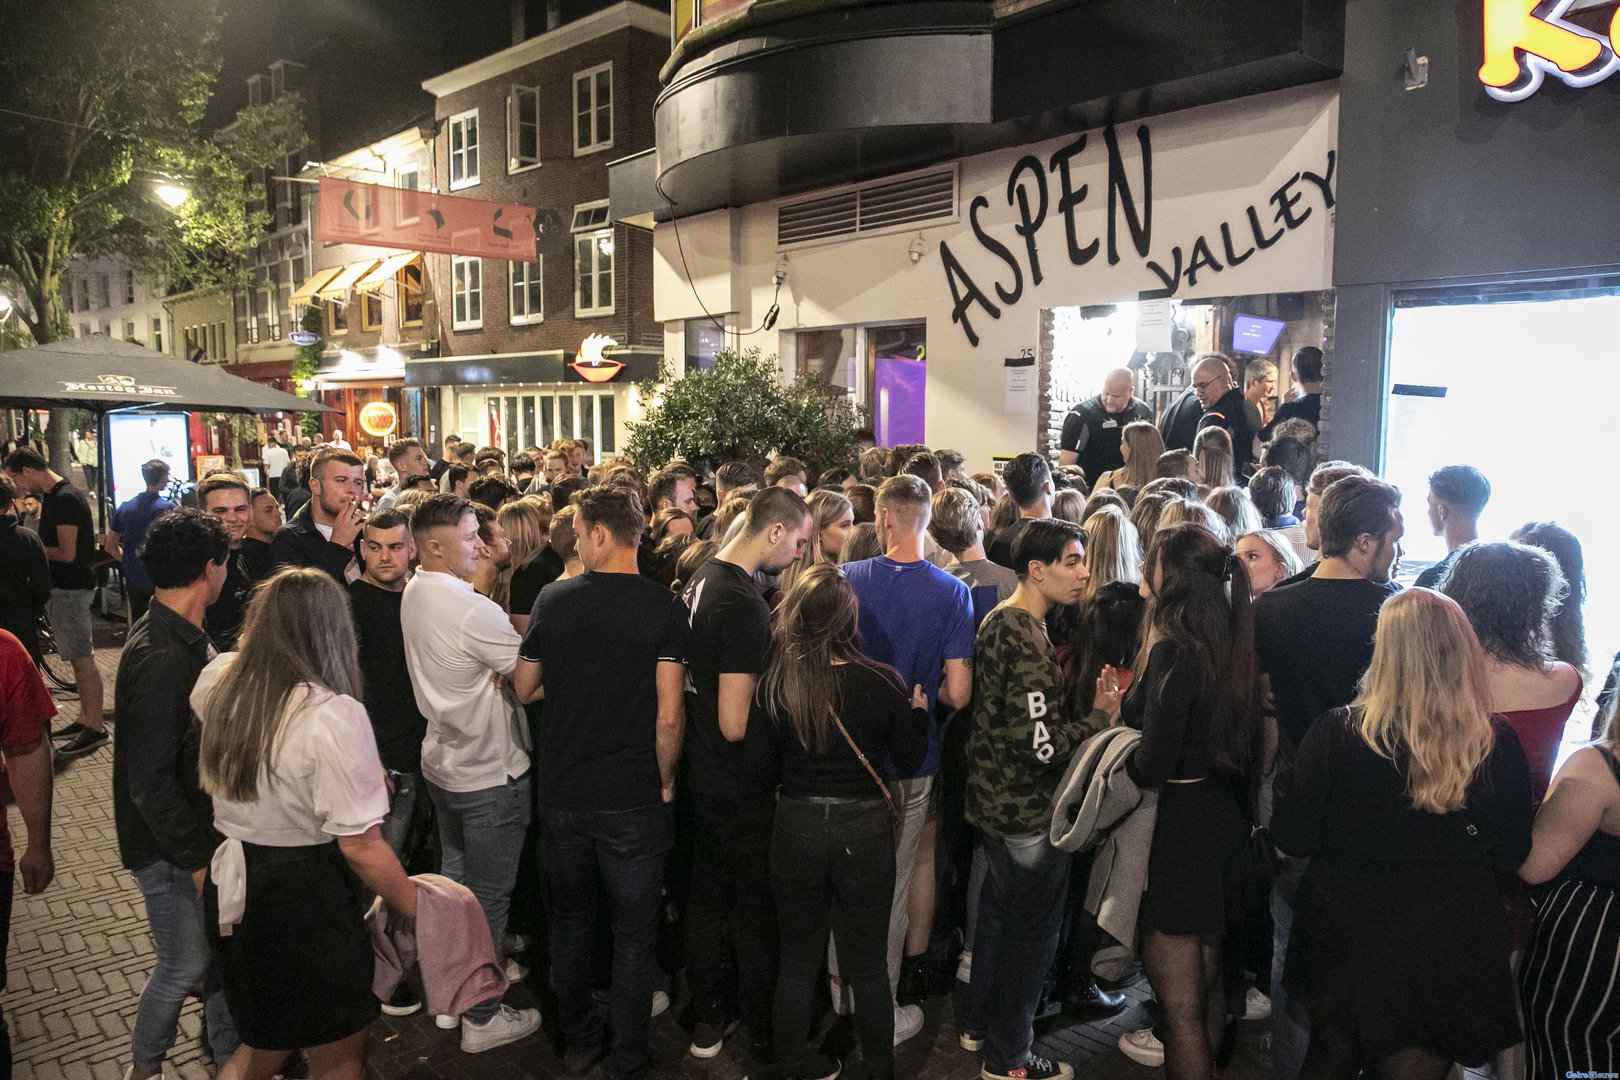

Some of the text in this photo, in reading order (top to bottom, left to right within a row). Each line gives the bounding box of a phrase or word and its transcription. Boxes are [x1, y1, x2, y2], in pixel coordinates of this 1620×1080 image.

[939, 124, 1153, 348] ASPEN
[1145, 149, 1337, 298] VALLEY
[64, 382, 176, 395] Hertog Jan
[1020, 348, 1034, 359] 25
